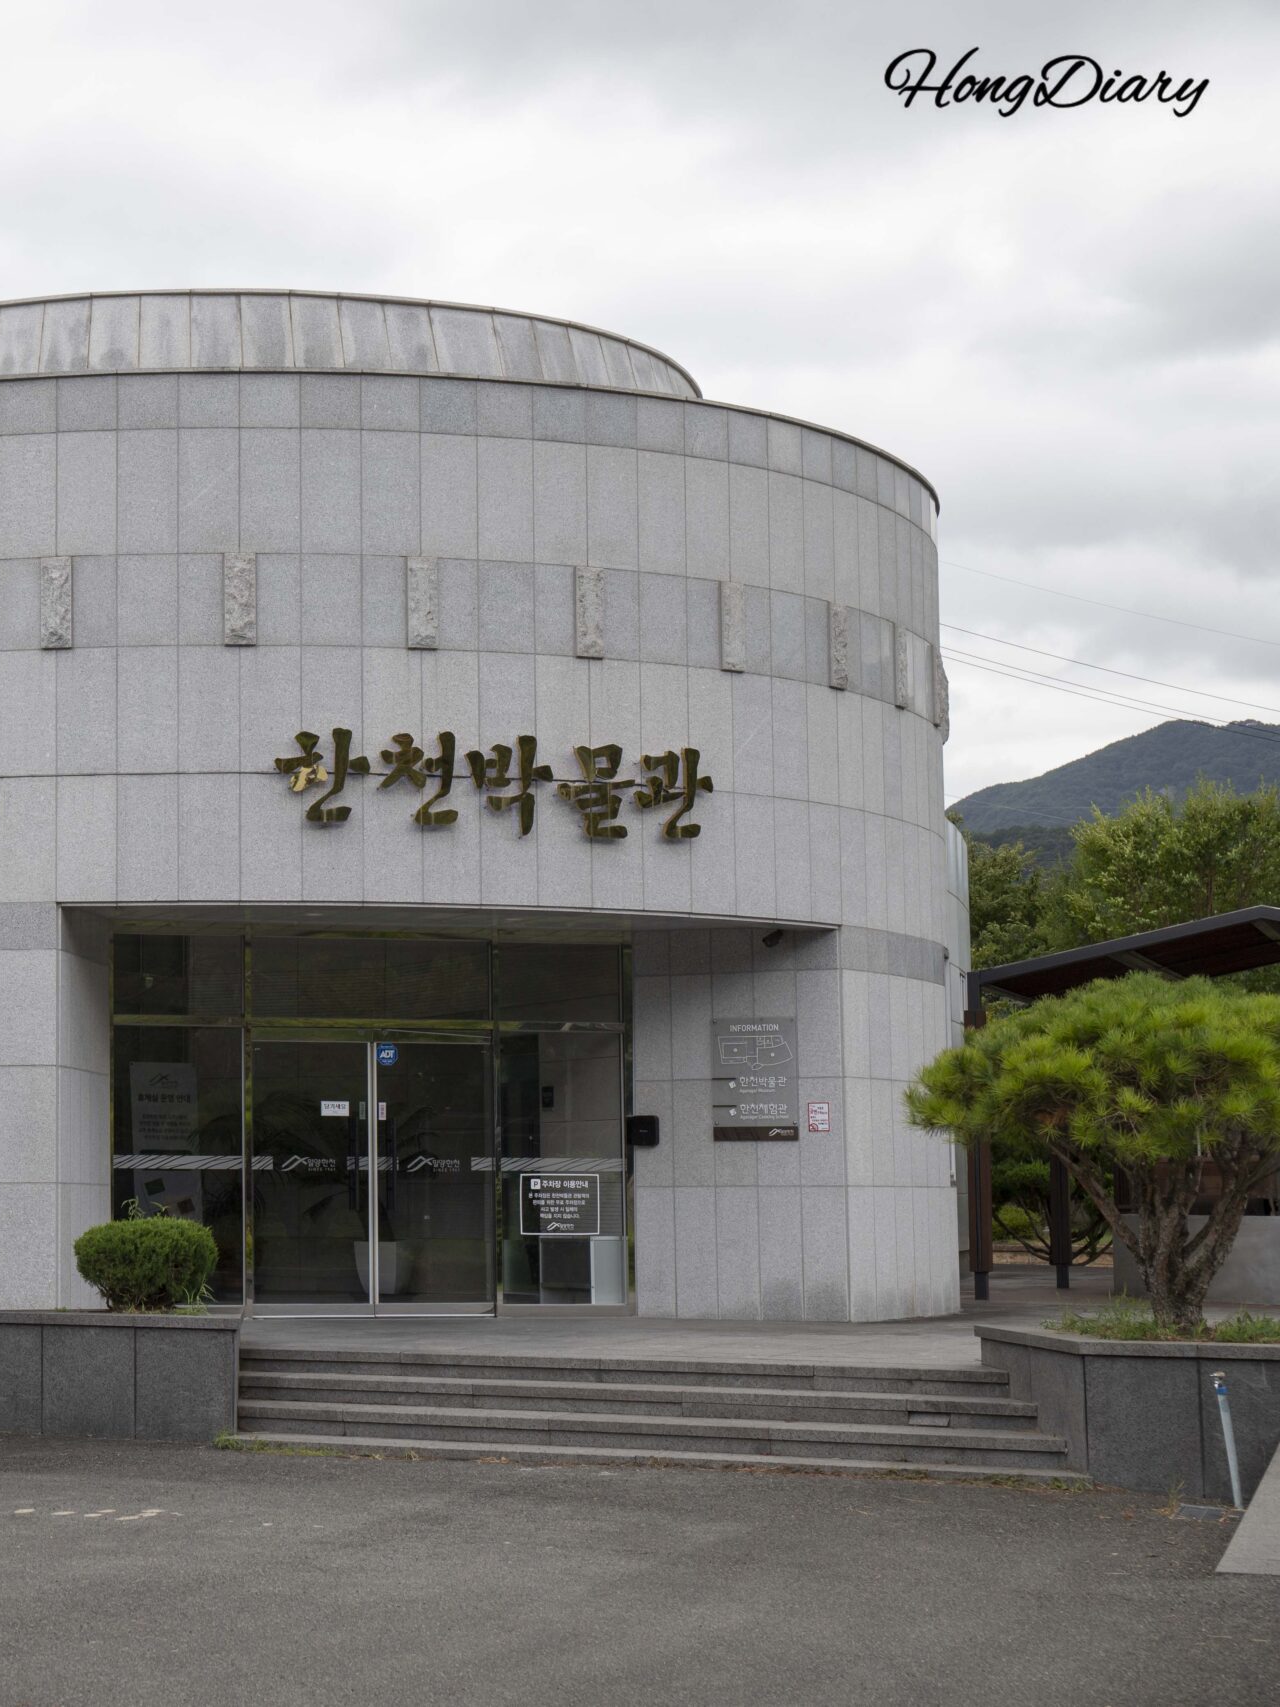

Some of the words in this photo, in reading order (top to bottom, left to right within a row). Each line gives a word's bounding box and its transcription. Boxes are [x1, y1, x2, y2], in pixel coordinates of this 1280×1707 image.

[274, 727, 714, 839] 한천박물관
[729, 1023, 780, 1032] INFORMATION
[379, 1049, 395, 1059] ADT
[740, 1076, 787, 1088] 한천박물관
[740, 1104, 787, 1114] 한천체험관
[542, 1180, 561, 1189] 주차장
[563, 1180, 589, 1189] 이용안내
